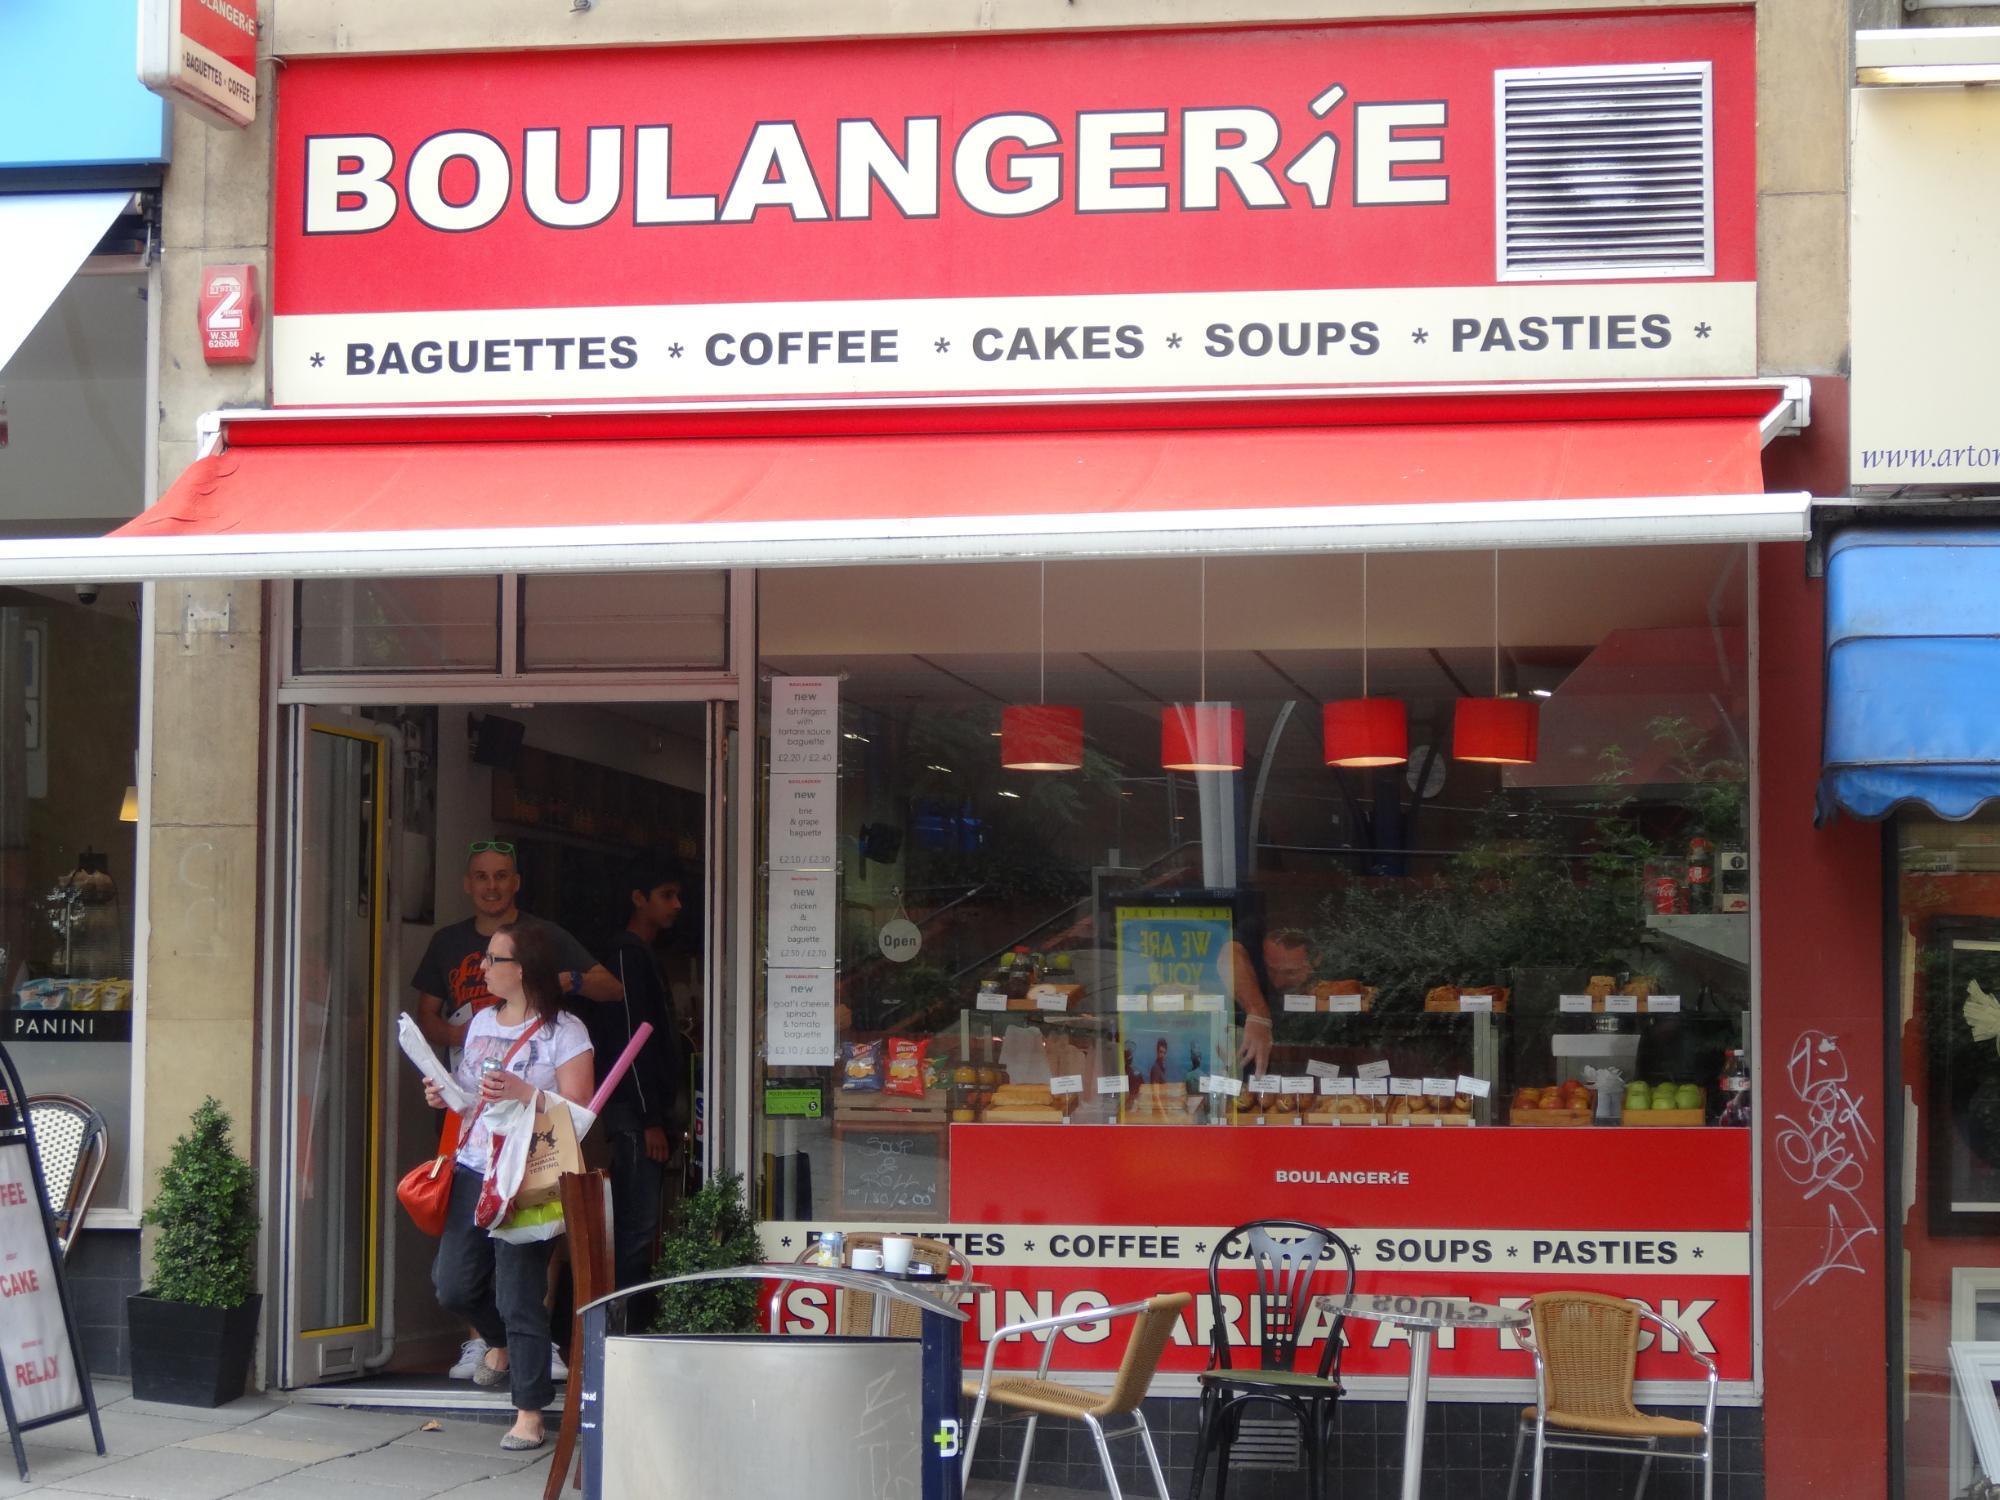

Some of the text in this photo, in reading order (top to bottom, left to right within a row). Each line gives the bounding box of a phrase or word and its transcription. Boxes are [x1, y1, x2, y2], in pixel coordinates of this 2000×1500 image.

[186, 51, 250, 104] BAGUETTES COFFEE
[345, 313, 1672, 376] BAGUETTES COFFEE CAKES SOUPS PASTIES
[794, 693, 817, 701] new
[793, 888, 816, 897] new
[790, 902, 817, 910] chicken
[884, 935, 917, 948] Open
[790, 985, 814, 993] new
[786, 1010, 817, 1019] spinach
[15, 1018, 94, 1034] PANINI
[810, 1102, 817, 1110] 5
[1049, 1234, 1181, 1259] COFFEE
[1375, 1238, 1493, 1264] SOUPS
[1532, 1240, 1678, 1265] PASTIES
[0, 1268, 40, 1298] CAKE
[785, 1287, 1111, 1346] SING
[1498, 1296, 1718, 1354] BK
[15, 1354, 59, 1388] RELAX
